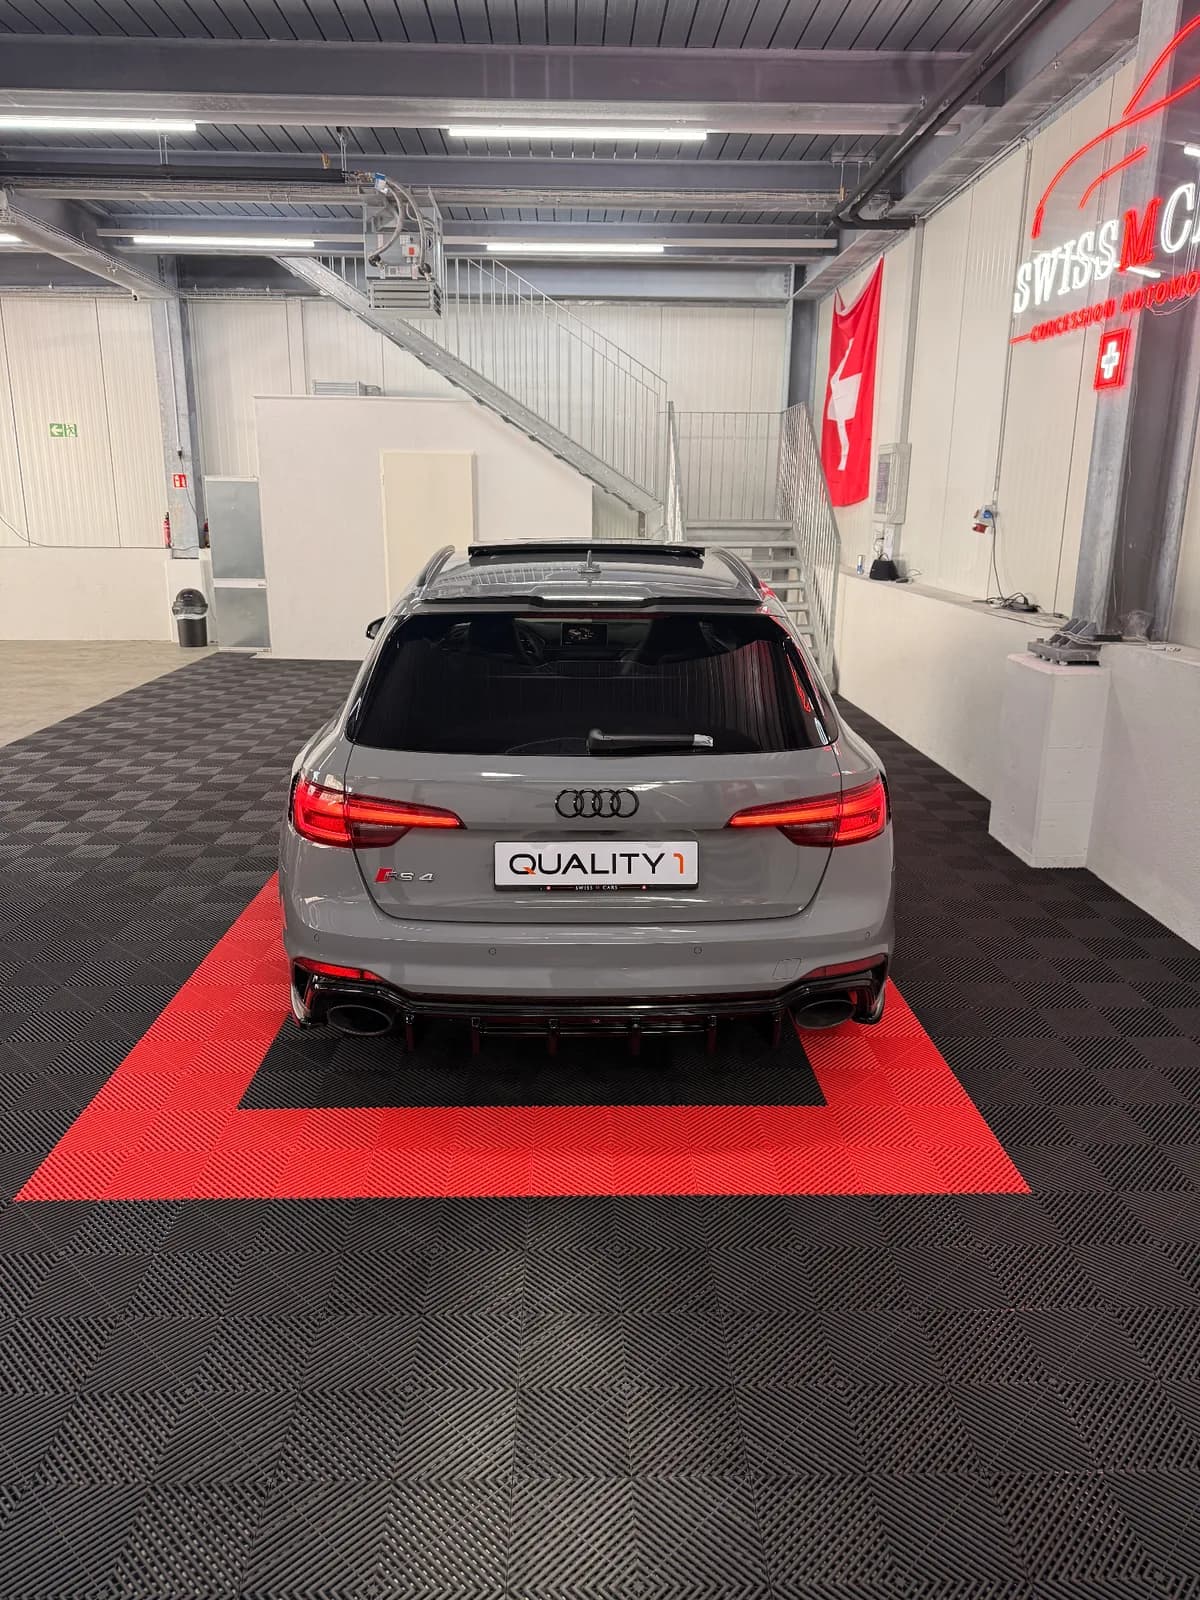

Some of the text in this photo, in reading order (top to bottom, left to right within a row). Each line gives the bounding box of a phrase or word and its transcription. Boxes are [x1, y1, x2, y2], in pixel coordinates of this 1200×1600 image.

[1030, 298, 1116, 343] CONCESSION
[509, 853, 684, 875] QUALITY 1
